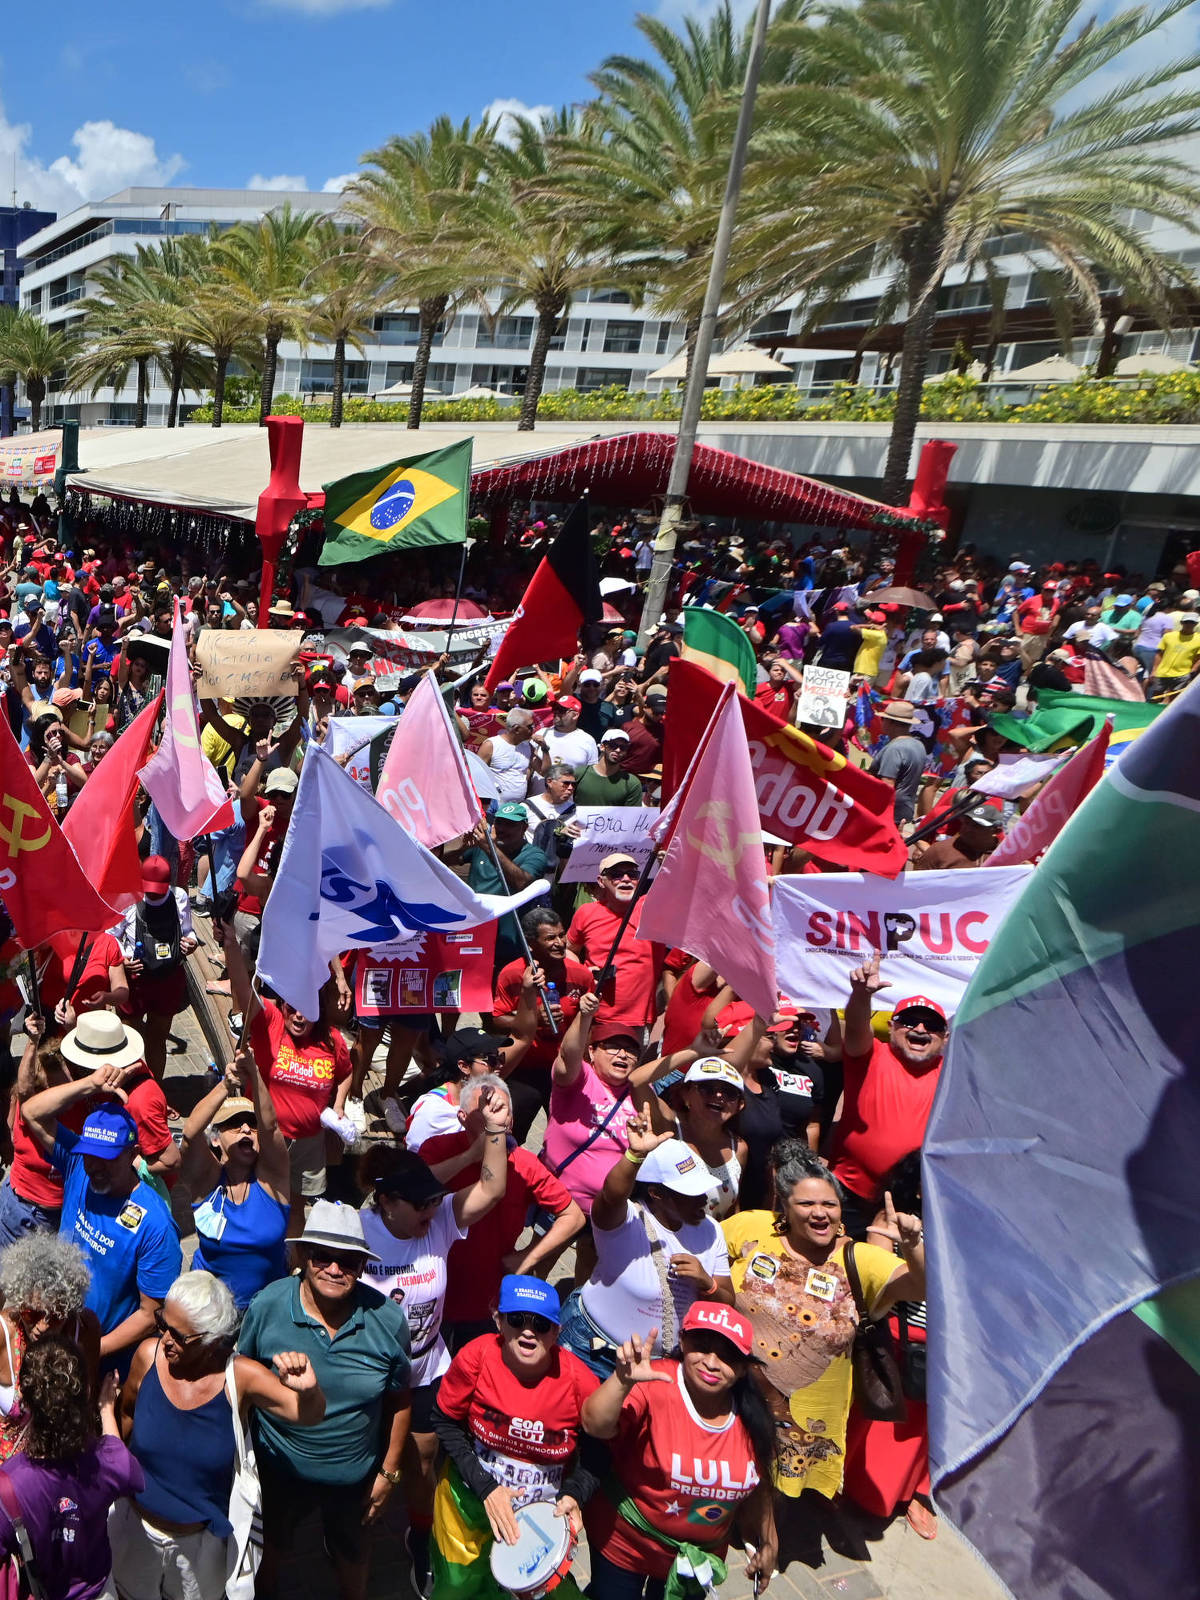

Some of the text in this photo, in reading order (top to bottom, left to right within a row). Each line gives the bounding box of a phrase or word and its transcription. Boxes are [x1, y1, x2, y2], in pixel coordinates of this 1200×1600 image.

[444, 623, 510, 642] CONGRESSO
[805, 676, 844, 689] MOTTA
[808, 667, 846, 680] HUGO
[805, 910, 990, 954] SINPUC
[289, 1058, 335, 1079] PCdoB 65
[775, 1074, 814, 1093] NPUC
[99, 1233, 115, 1248] DOS
[698, 1310, 744, 1338] LULA
[526, 1445, 569, 1456] DEMOCRACIA
[671, 1452, 760, 1490] LULA
[670, 1482, 751, 1501] PRESIDENT
